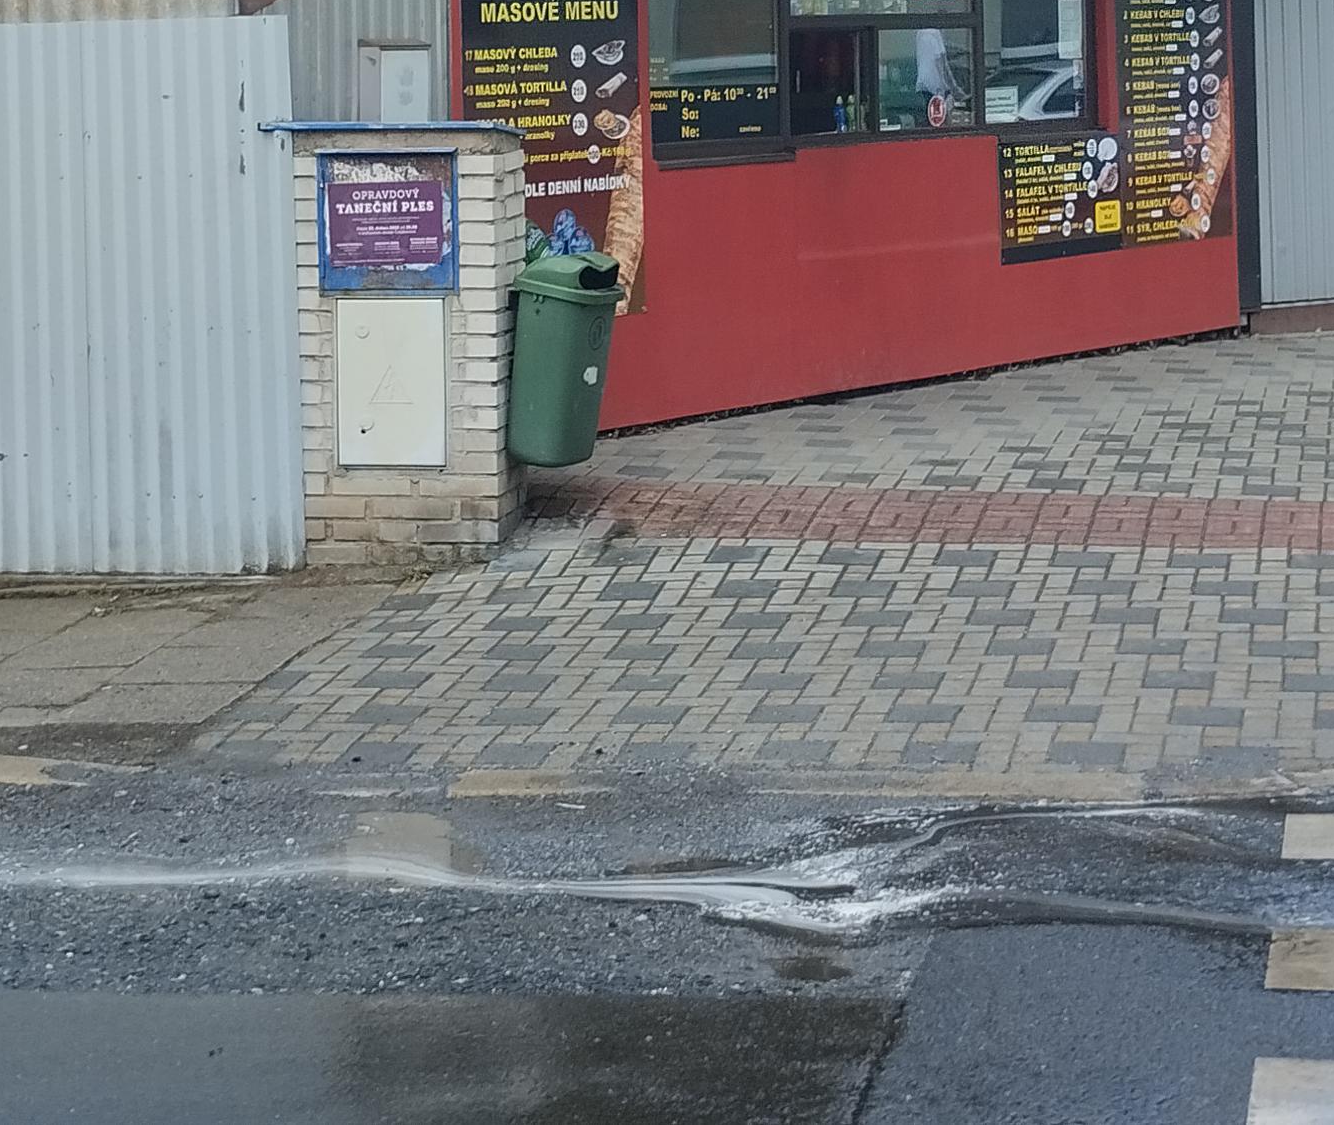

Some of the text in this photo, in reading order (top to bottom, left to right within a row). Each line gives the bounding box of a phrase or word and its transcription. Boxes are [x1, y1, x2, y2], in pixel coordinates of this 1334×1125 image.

[566, 0, 619, 20] MENU
[474, 46, 517, 61] MASOVÝ
[519, 46, 557, 60] CHLEBA
[475, 80, 518, 96] MASOVÁ
[519, 79, 567, 94] TORTILLA
[680, 90, 695, 103] Po
[518, 113, 571, 128] HRANOLKY
[548, 177, 581, 195] DENNÍ
[583, 174, 630, 193] NABÍDKY
[352, 187, 420, 201] OPRAVDOVÝ
[336, 200, 435, 215] TANEČNÍ PLES
